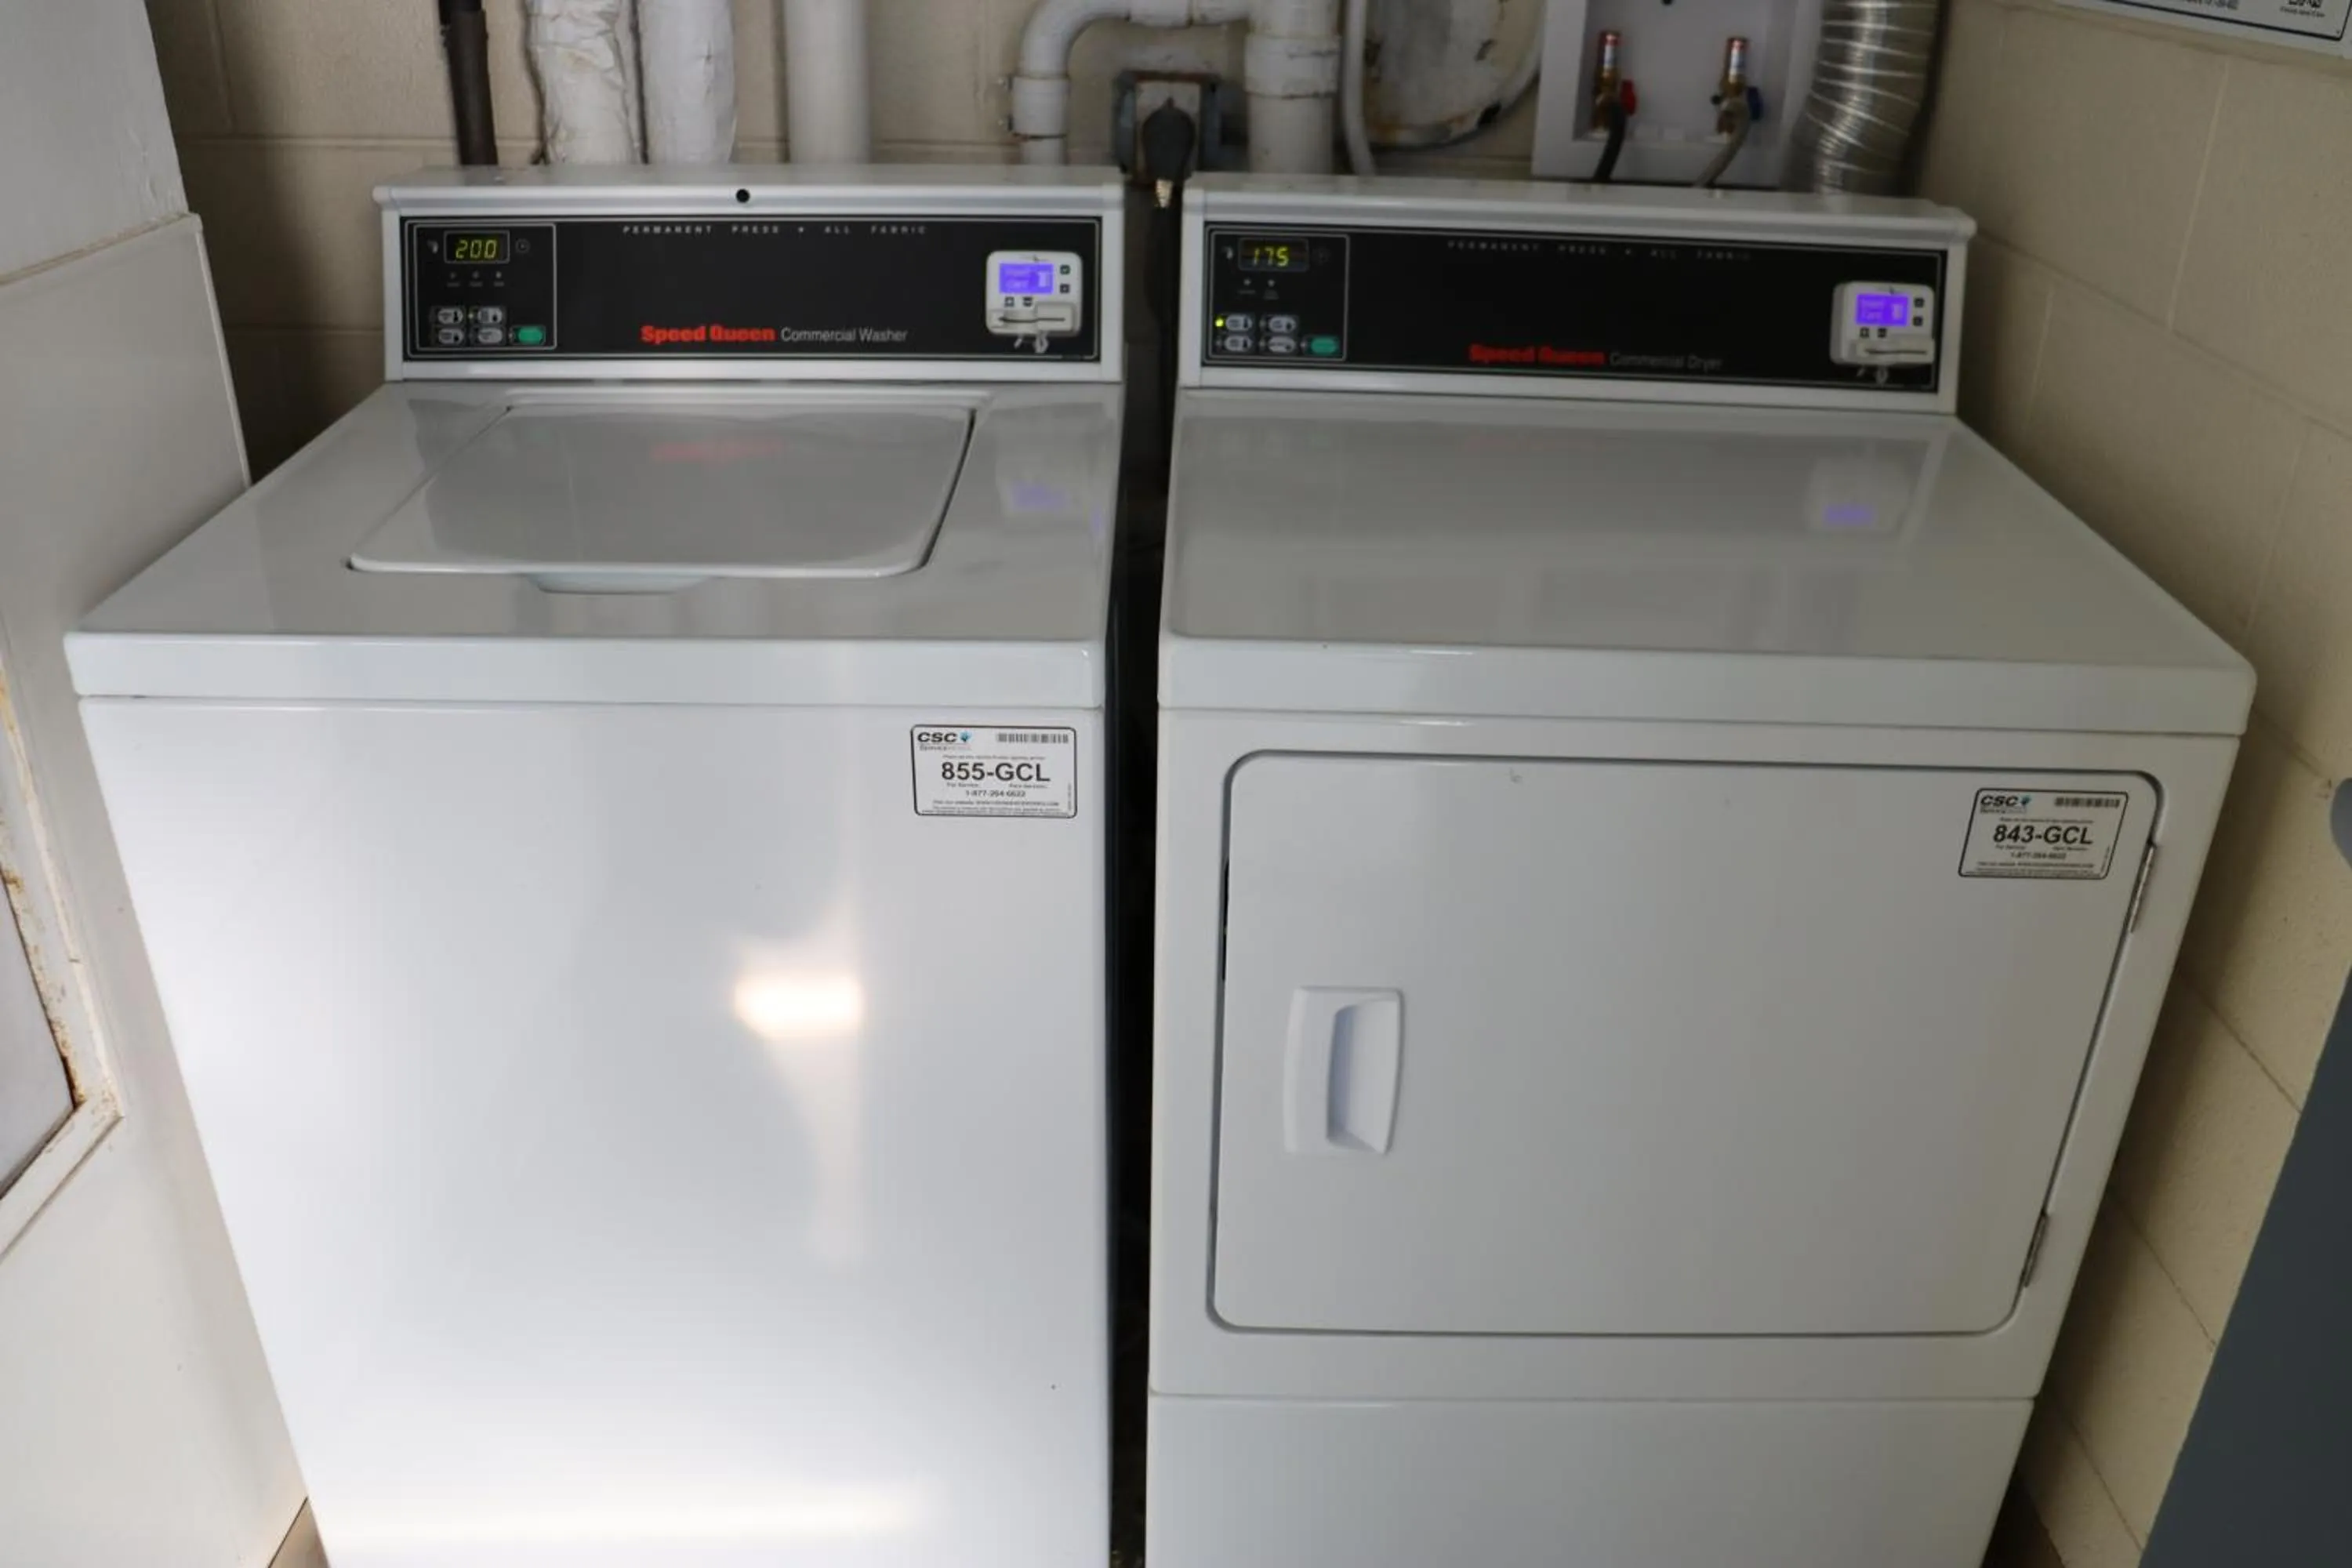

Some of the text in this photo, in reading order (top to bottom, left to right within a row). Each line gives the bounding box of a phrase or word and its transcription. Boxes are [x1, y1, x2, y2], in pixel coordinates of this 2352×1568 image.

[623, 225, 927, 235] PERMANENT PRESS ALL FABRIC
[455, 239, 498, 260] 200
[1253, 246, 1290, 267] 175
[641, 325, 909, 344] Speed Queen Commercial Washer
[1688, 354, 1723, 372] Dryer
[916, 731, 958, 743] CSC
[941, 761, 1051, 782] 855-GCL
[1980, 795, 2020, 807] CSC
[1992, 824, 2094, 844] 843-GCL
